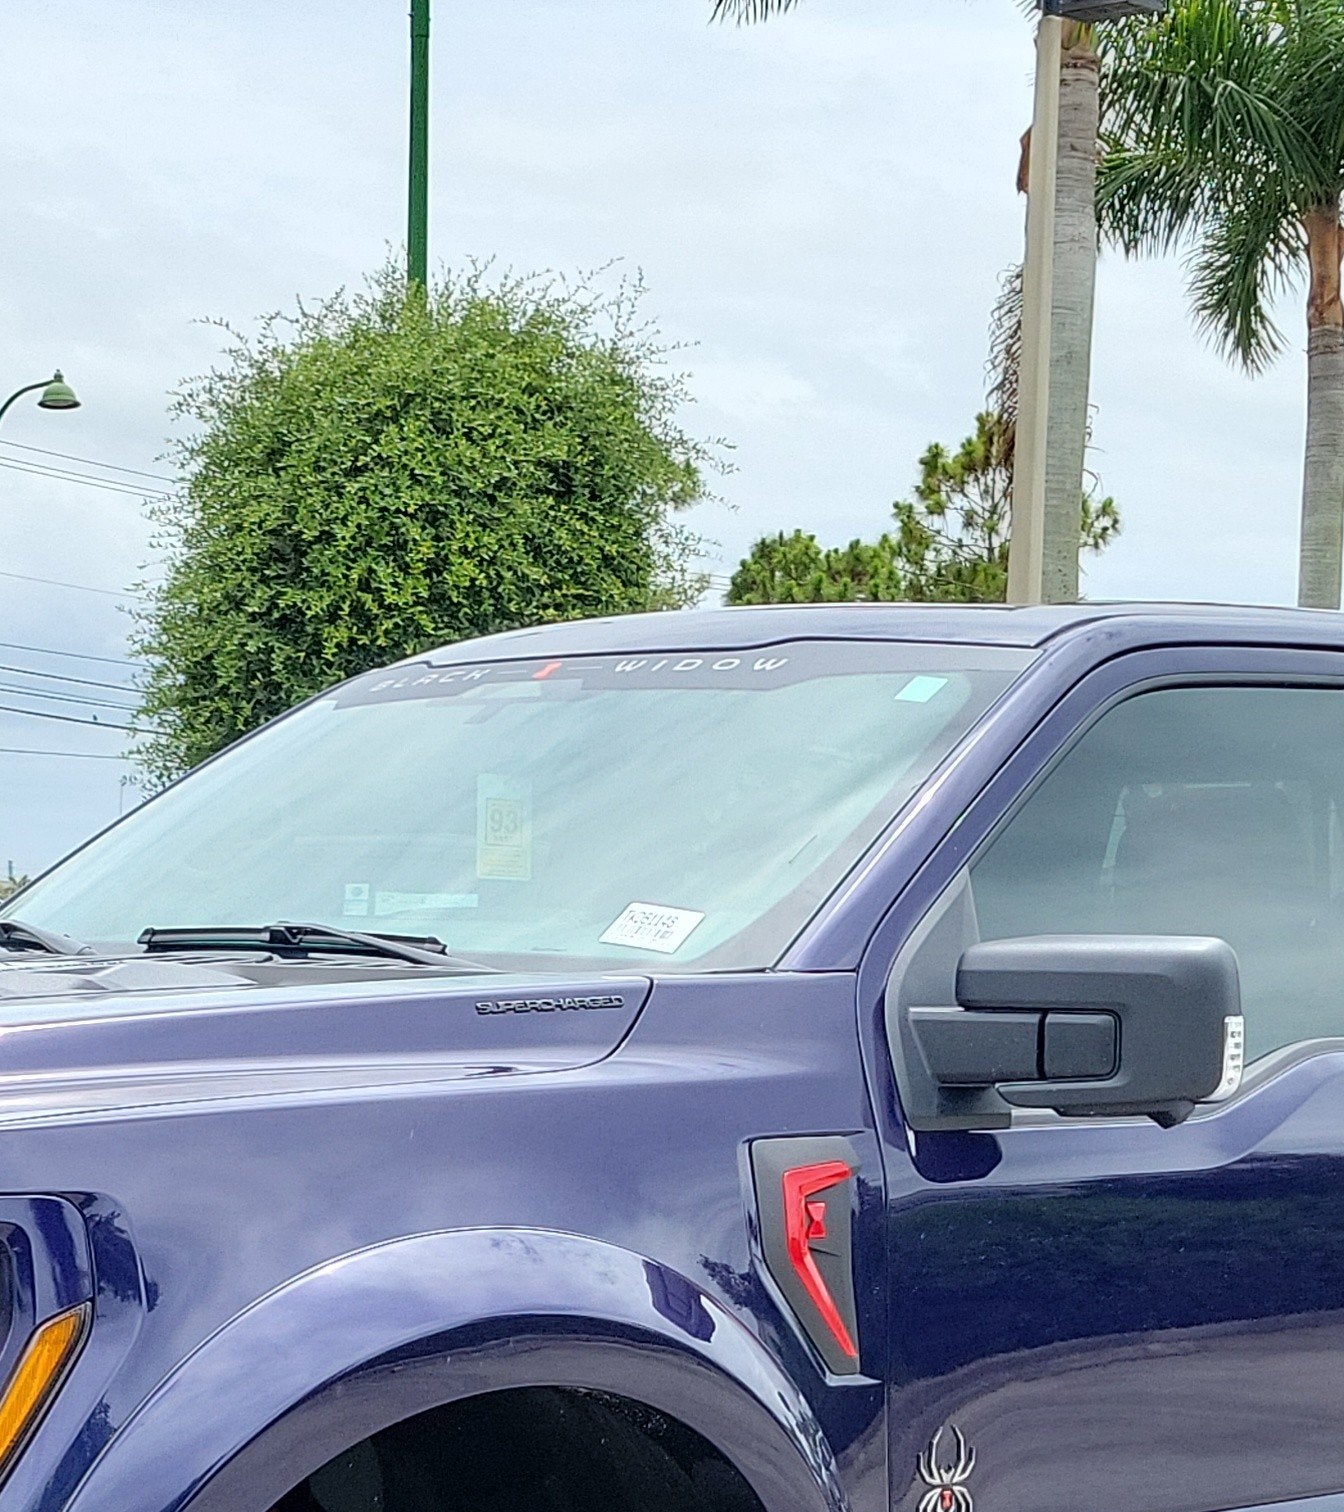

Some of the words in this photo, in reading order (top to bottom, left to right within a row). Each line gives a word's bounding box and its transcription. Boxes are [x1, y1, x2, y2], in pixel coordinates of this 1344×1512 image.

[369, 668, 491, 692] BLACK
[615, 657, 789, 673] WIDOW
[475, 995, 626, 1016] SUPERCHARGED
